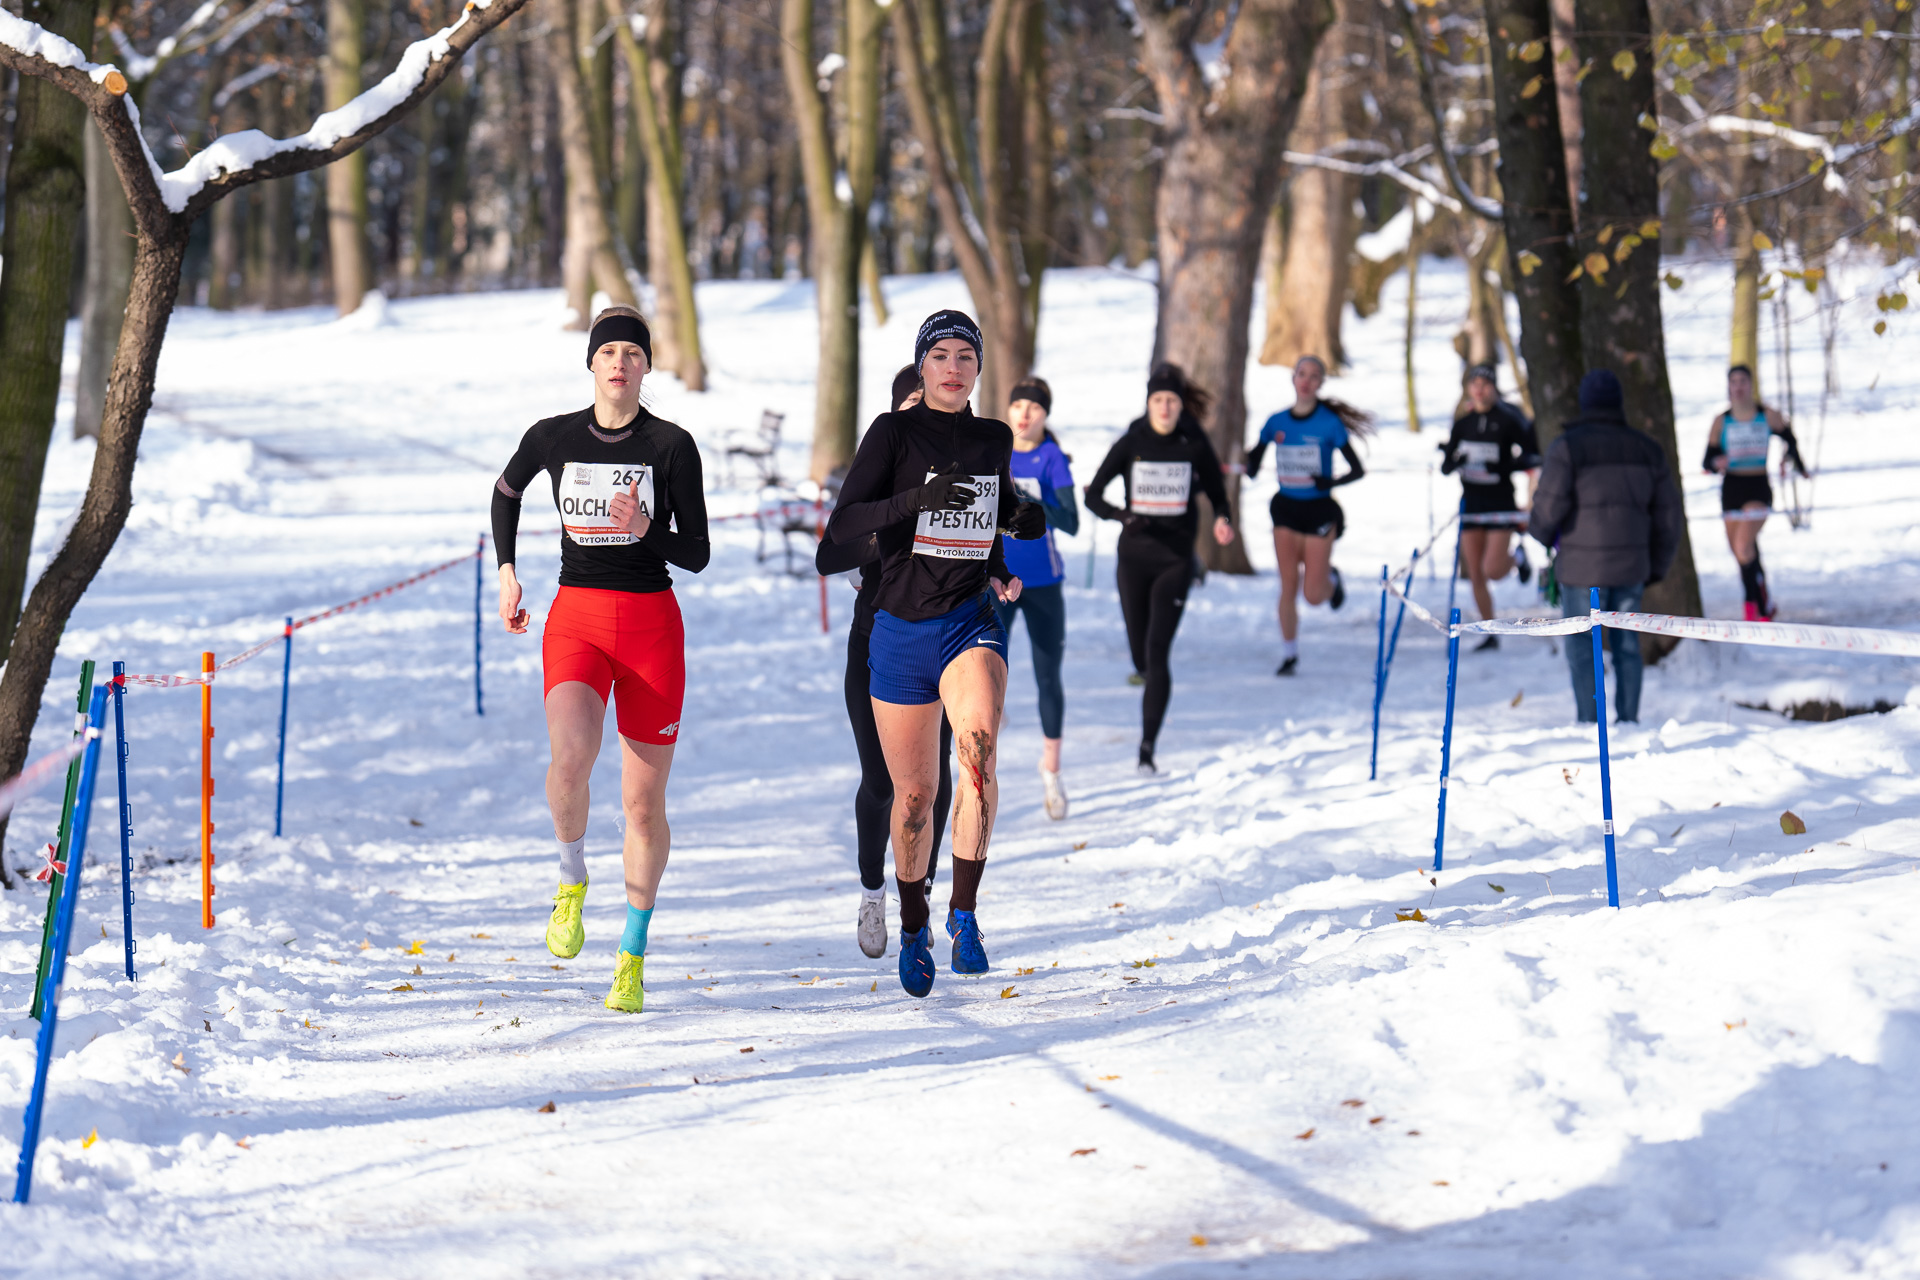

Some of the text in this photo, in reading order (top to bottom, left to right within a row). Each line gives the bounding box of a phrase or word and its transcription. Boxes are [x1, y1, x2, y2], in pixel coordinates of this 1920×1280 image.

[612, 470, 645, 486] 267
[974, 481, 997, 498] 393
[563, 497, 650, 518] OLCHA
[929, 510, 993, 530] PESTKA
[936, 548, 966, 557] BYTOM
[658, 720, 680, 736] 4F
